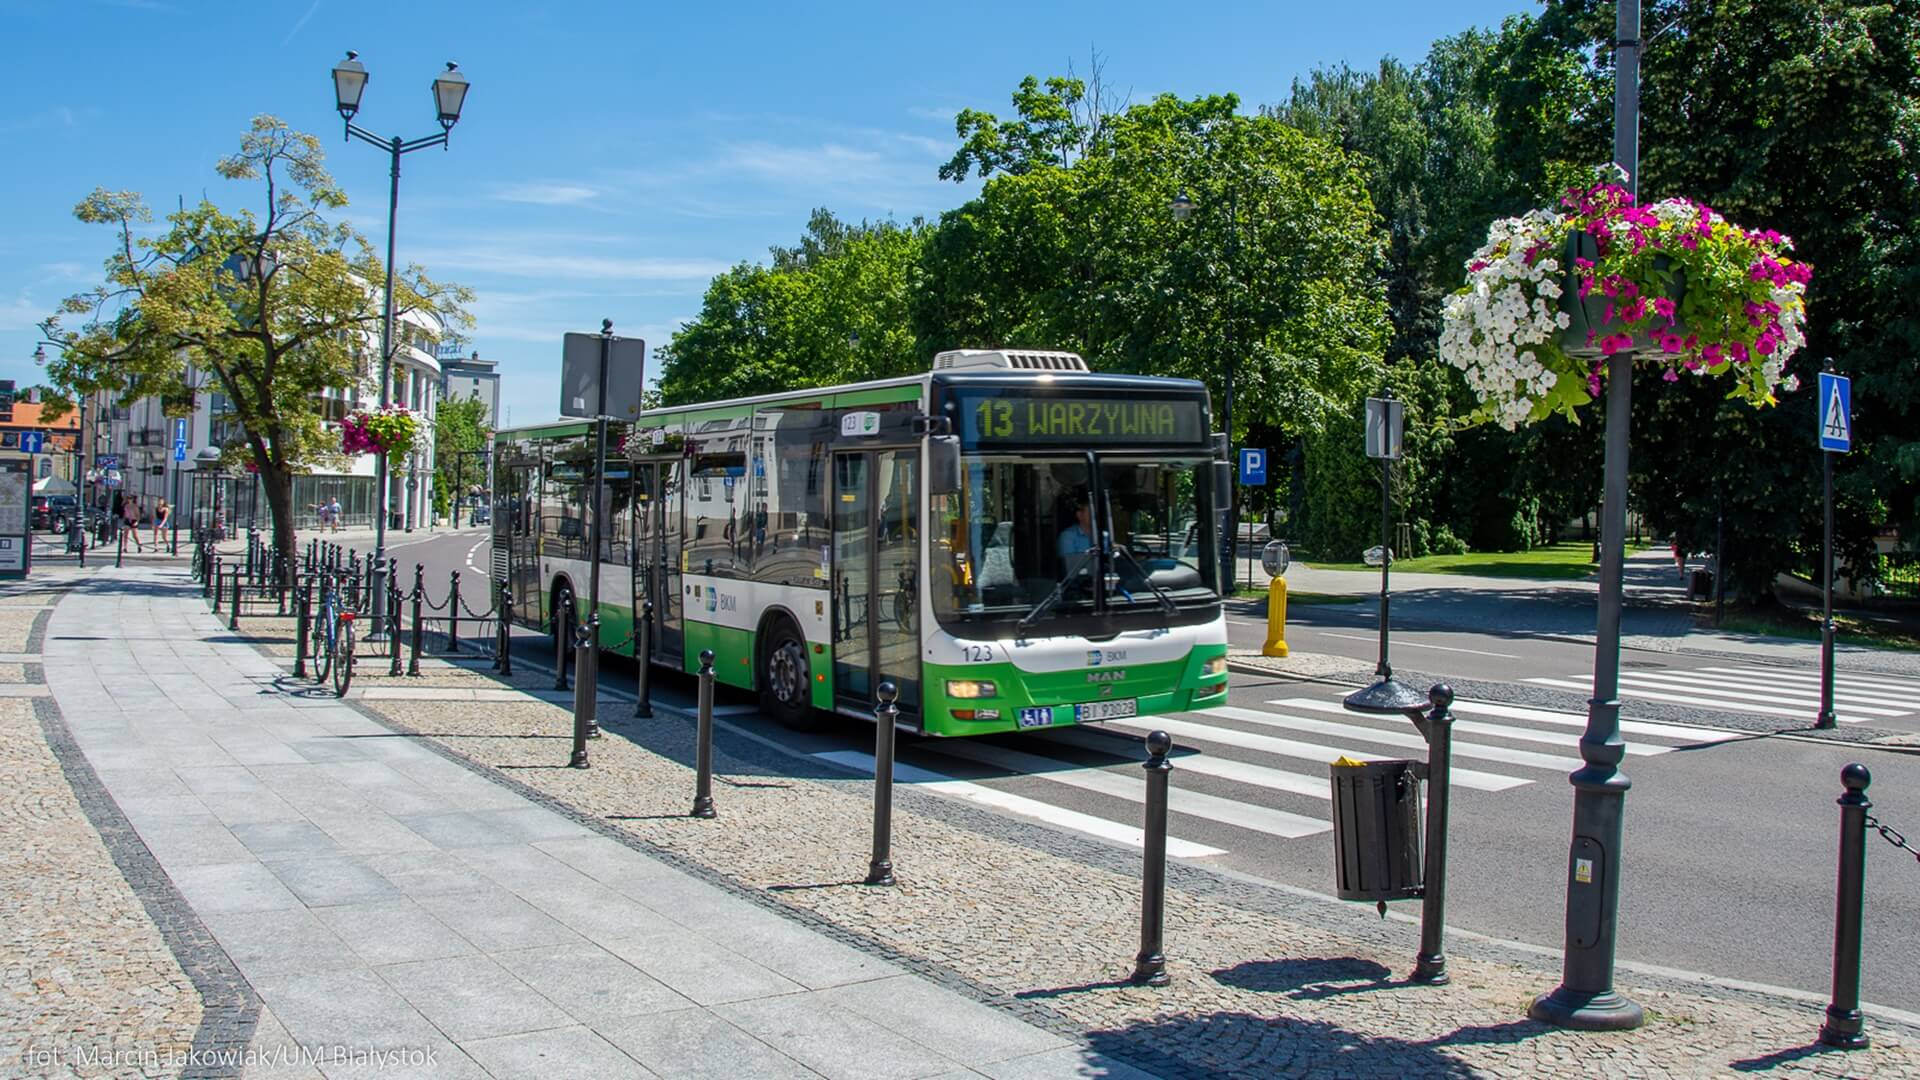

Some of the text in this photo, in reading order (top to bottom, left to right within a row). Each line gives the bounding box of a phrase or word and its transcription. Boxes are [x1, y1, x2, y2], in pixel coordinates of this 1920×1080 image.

[844, 415, 856, 430] 123
[976, 400, 1175, 437] 13 WARZYWNA
[1246, 452, 1261, 475] P
[720, 593, 736, 612] BKM
[961, 645, 993, 662] 123
[1087, 671, 1126, 682] MAN
[1082, 704, 1097, 719] BI
